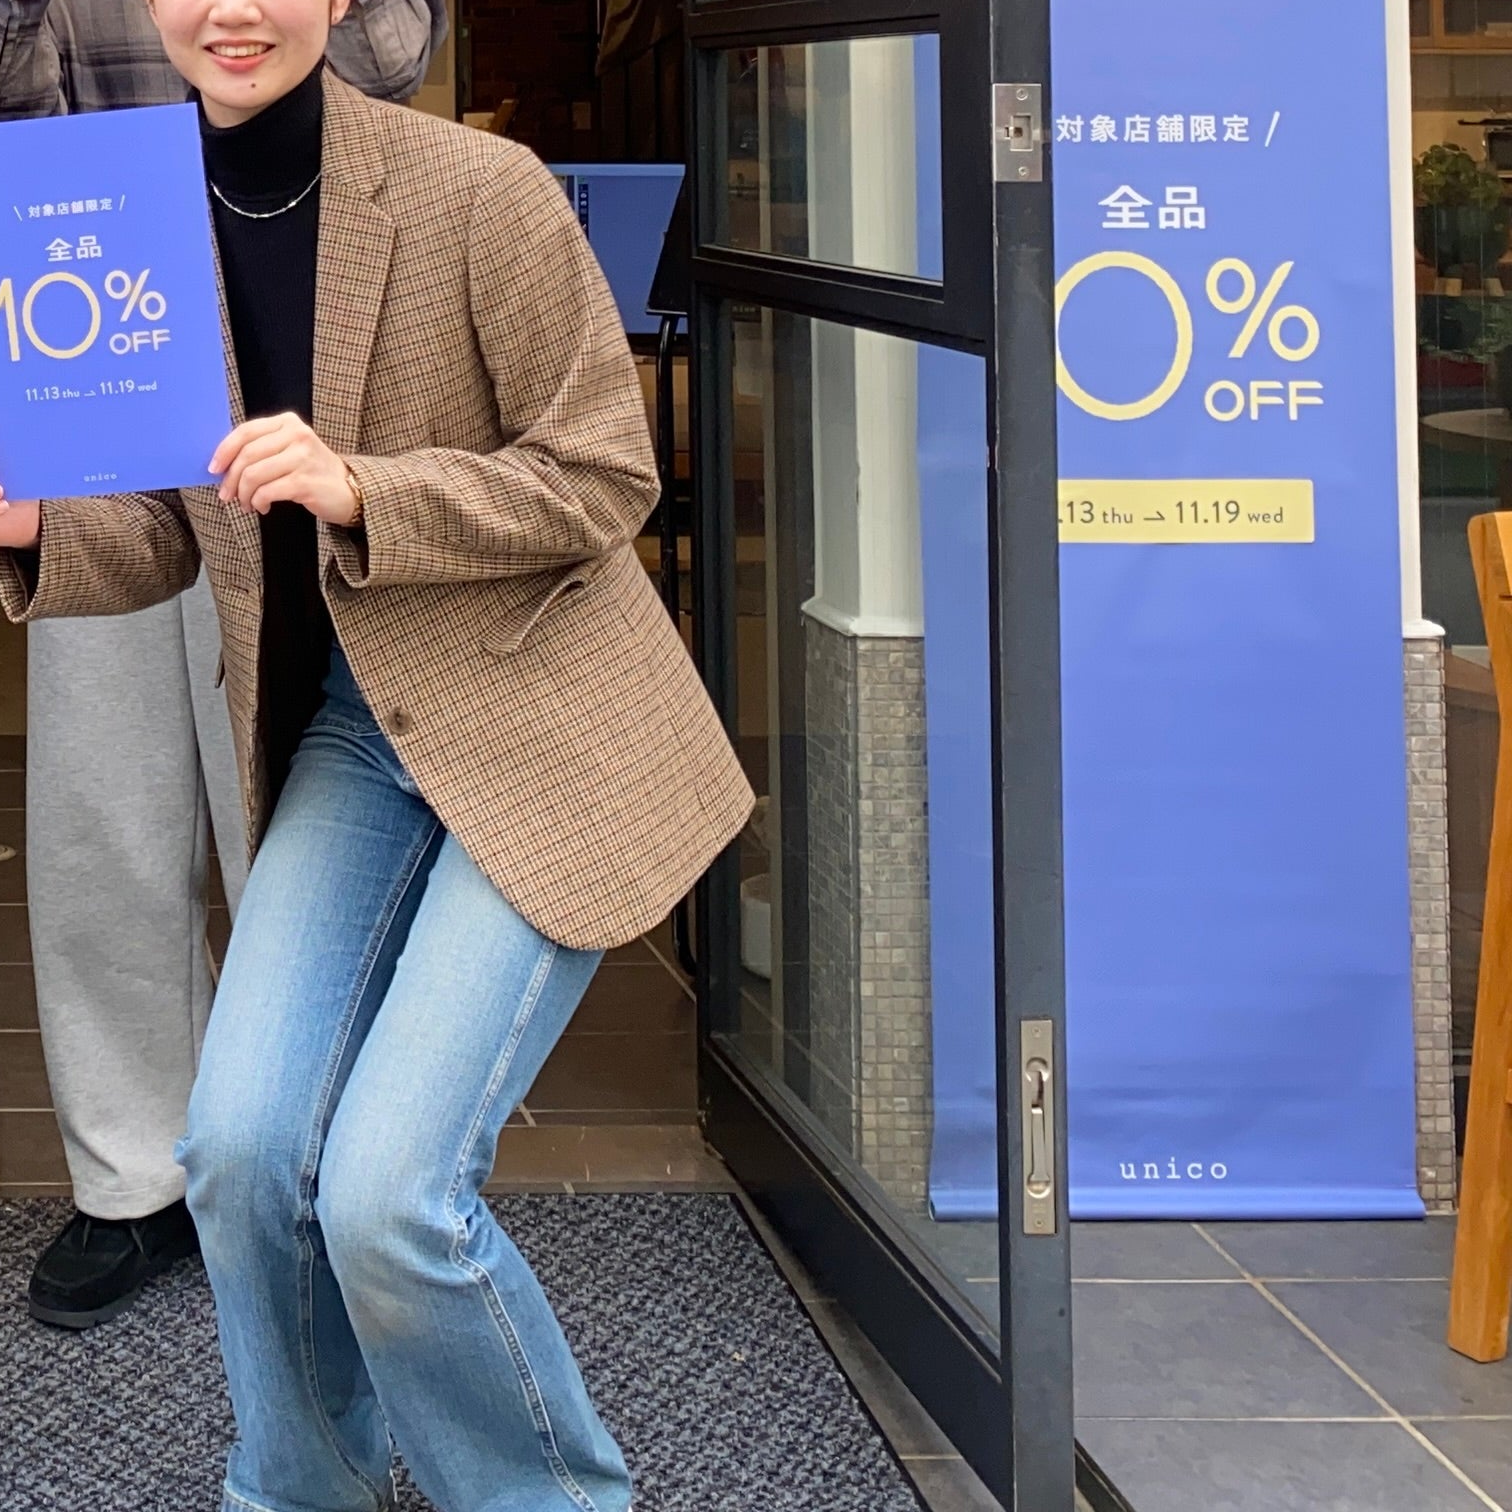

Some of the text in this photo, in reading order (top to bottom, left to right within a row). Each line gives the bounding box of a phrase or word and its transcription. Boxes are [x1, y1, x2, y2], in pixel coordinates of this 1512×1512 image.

[1055, 114, 1250, 144] 対象店舗限定
[27, 196, 114, 220] 対象店舗限定
[1098, 185, 1207, 230] 全品
[45, 235, 103, 262] 全品
[109, 328, 171, 355] OFF
[1055, 251, 1324, 422] 0% OFF
[25, 378, 158, 402] 11.13 thu 11.19 wed
[1102, 507, 1133, 524] thu
[1175, 500, 1241, 524] 11.19
[1247, 506, 1284, 524] wed
[1119, 1156, 1228, 1180] unico
